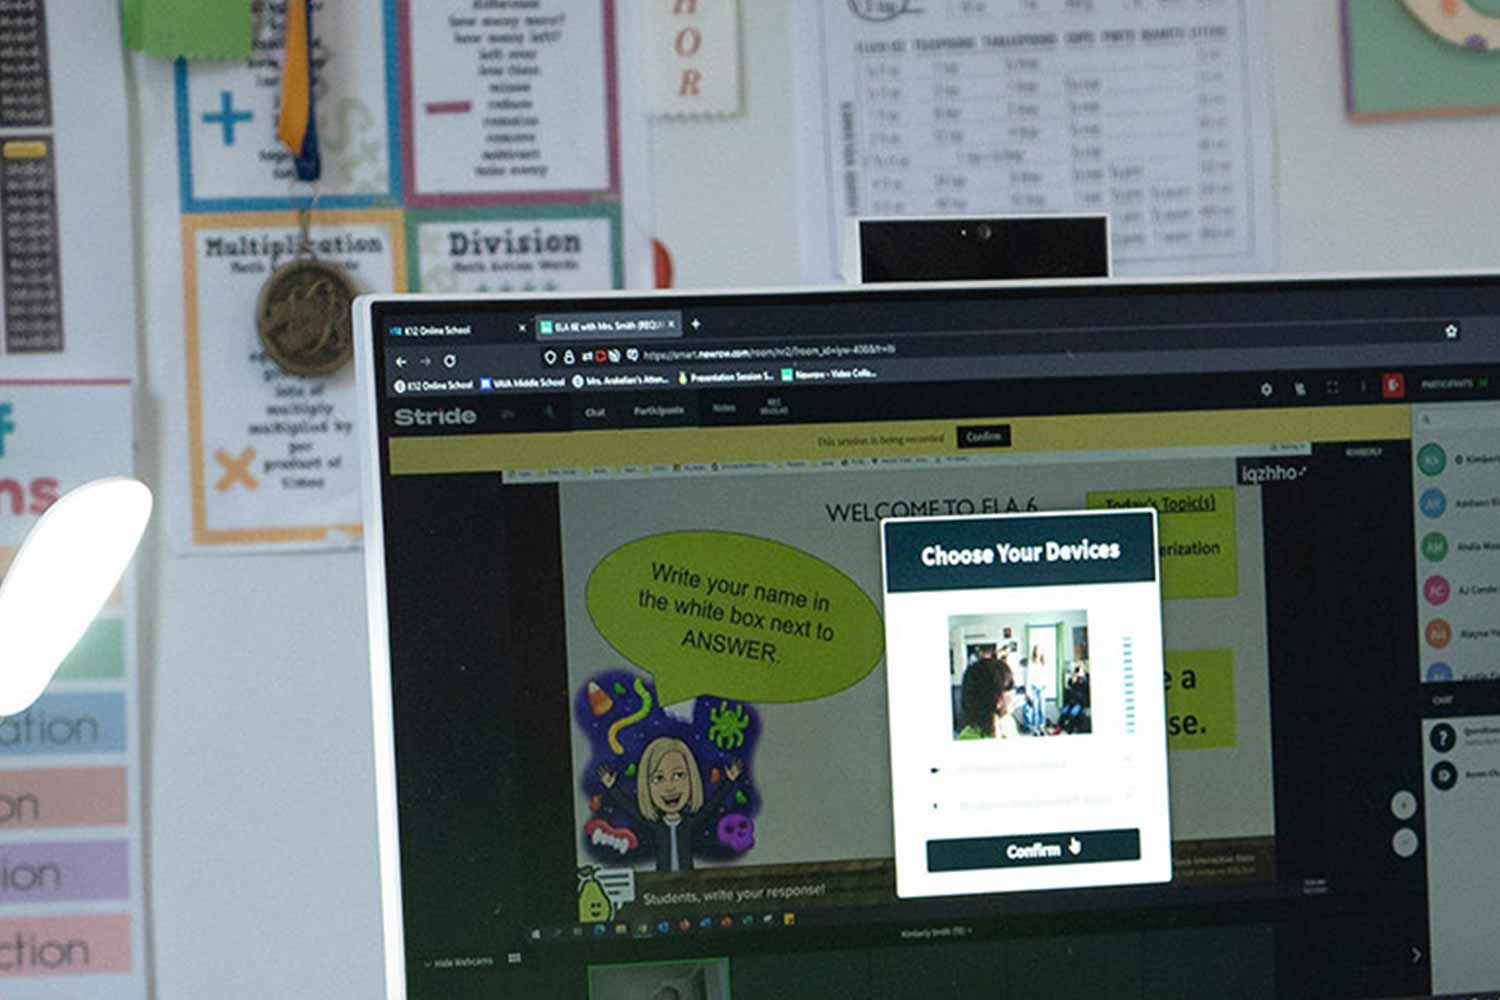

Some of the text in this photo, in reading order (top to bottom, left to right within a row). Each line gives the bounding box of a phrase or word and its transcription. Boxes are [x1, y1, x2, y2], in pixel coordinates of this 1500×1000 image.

[447, 226, 582, 257] Division
[691, 373, 729, 383] Presentation
[395, 408, 477, 427] Stride
[585, 408, 605, 417] Chat
[817, 433, 944, 448] This session is being recorded
[967, 431, 1002, 443] Confirm
[826, 501, 939, 522] WELCOME
[943, 499, 976, 516] TO
[1027, 496, 1039, 512] 6
[921, 538, 1121, 567] Choose Your Devices
[651, 562, 831, 612] Write your name in
[638, 589, 835, 643] the white box next to
[680, 628, 782, 665] ANSWER.
[1181, 668, 1197, 689] a
[0, 709, 98, 746] ation
[1007, 841, 1062, 859] Confirm
[643, 883, 826, 906] Students, write your response!
